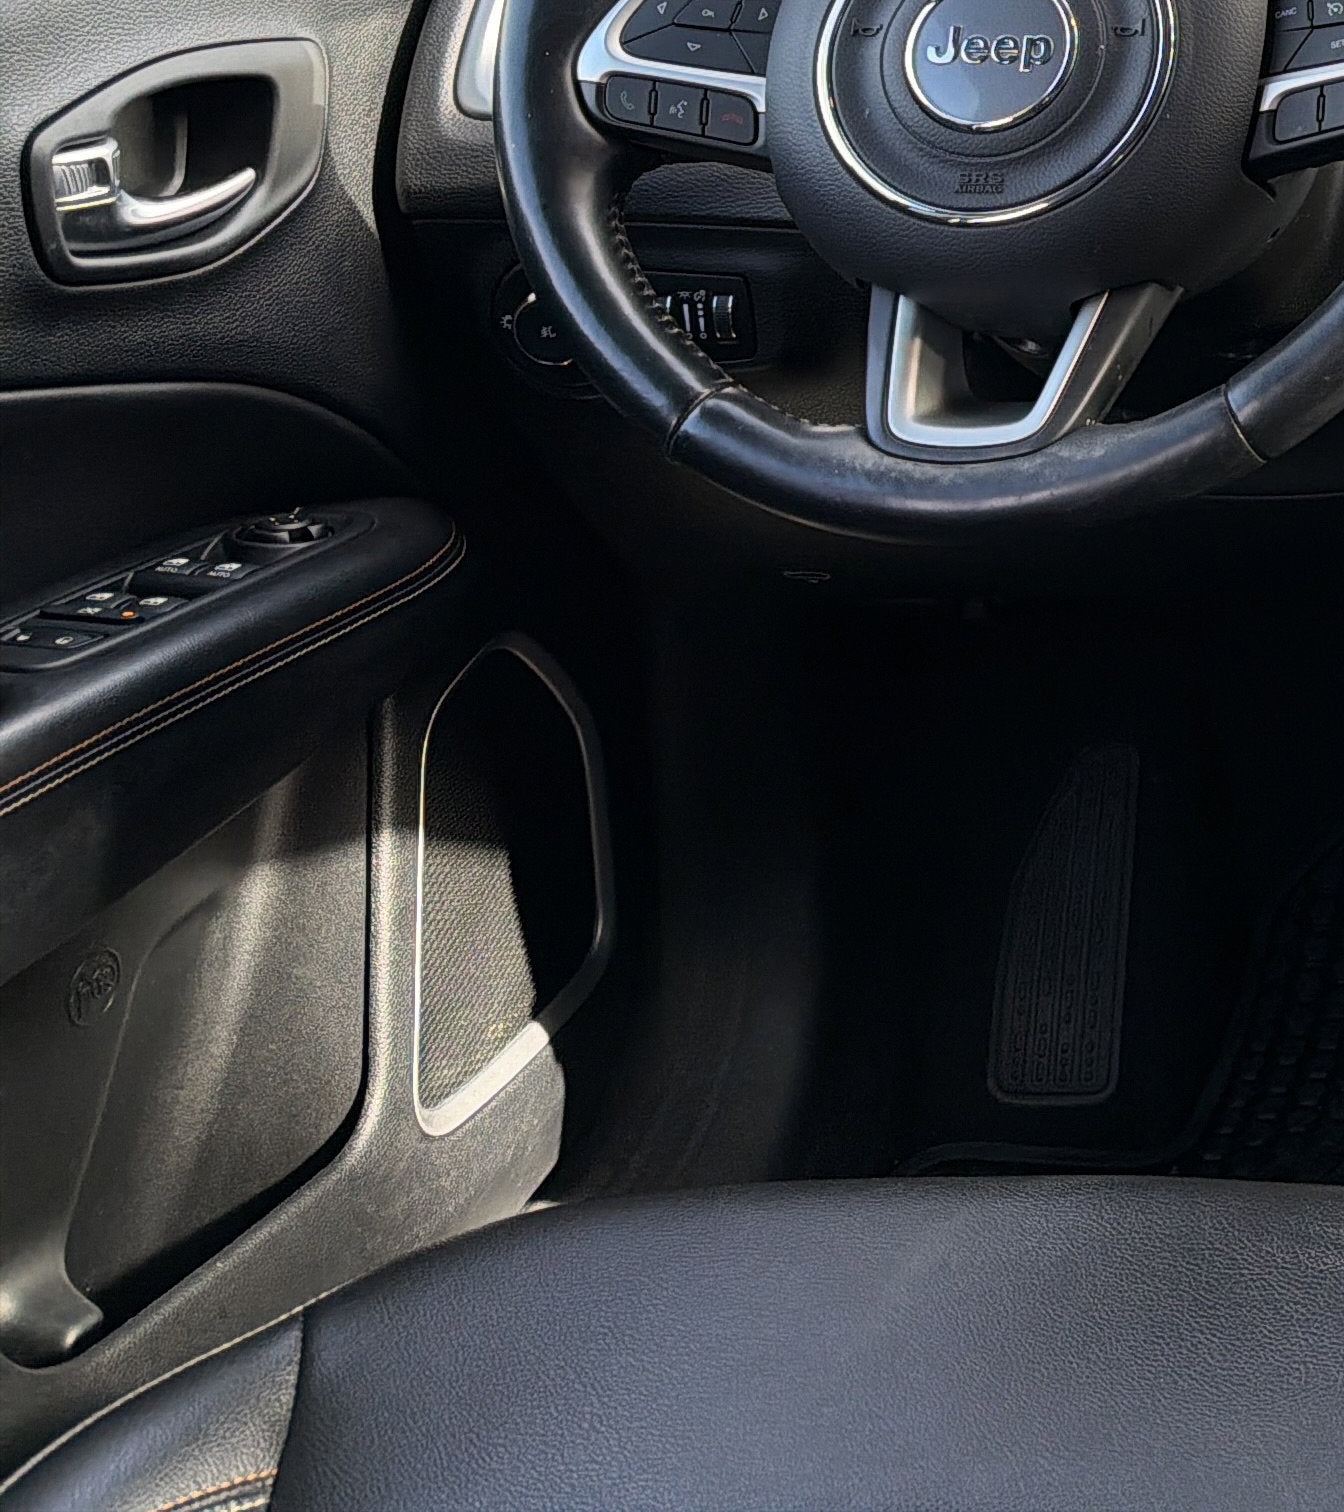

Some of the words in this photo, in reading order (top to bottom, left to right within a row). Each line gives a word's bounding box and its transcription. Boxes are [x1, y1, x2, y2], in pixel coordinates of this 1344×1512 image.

[1274, 7, 1297, 19] CANC
[926, 24, 1055, 73] Jeep
[959, 172, 1005, 183] SRS
[955, 183, 1006, 194] AIRBAG
